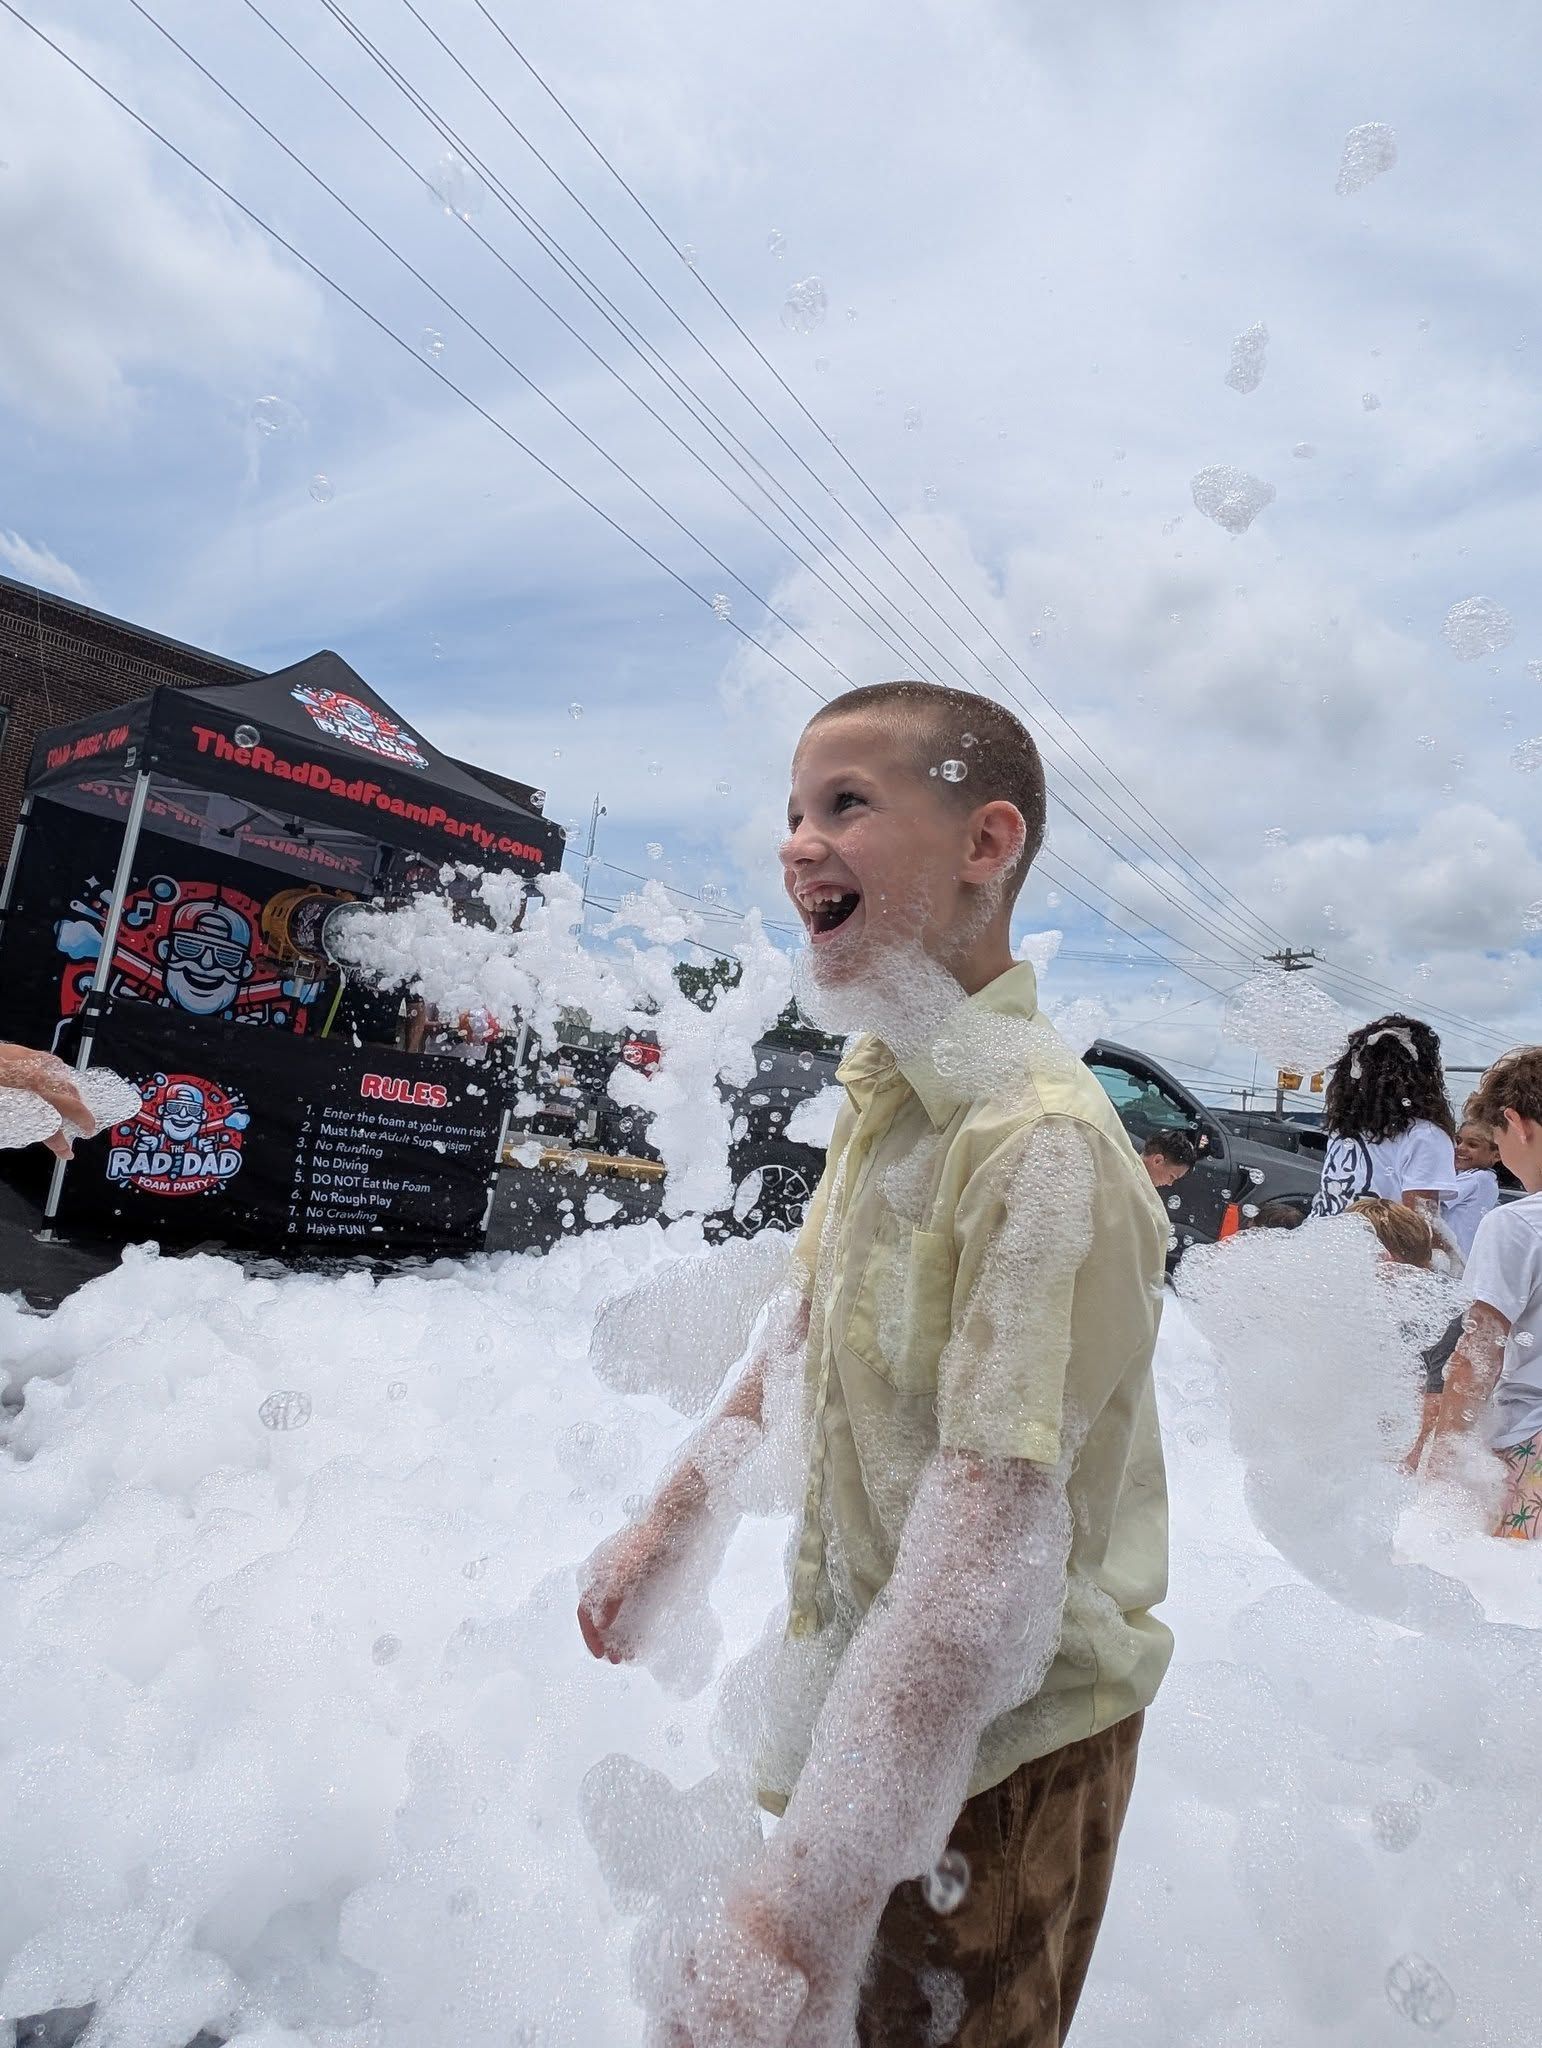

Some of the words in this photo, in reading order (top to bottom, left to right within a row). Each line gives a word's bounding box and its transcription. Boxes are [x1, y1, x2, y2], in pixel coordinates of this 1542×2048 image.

[317, 717, 371, 743] RAD
[378, 738, 425, 766] DAD
[191, 725, 543, 863] TheRadDadFoamParty.com
[361, 1073, 447, 1107] RULES
[323, 1107, 355, 1120] Enter
[357, 1112, 375, 1123] the
[377, 1114, 405, 1128] foam
[408, 1120, 418, 1129] at
[420, 1123, 442, 1133] your
[445, 1126, 466, 1136] own
[469, 1126, 486, 1138] risk
[320, 1124, 348, 1137] Must
[351, 1128, 377, 1140] have
[379, 1131, 409, 1144] Adult
[412, 1136, 471, 1151] Supvision
[170, 1145, 185, 1153] THE
[315, 1140, 332, 1151] No
[336, 1142, 383, 1159] Running
[109, 1150, 173, 1178] RAD
[181, 1150, 240, 1177] DAD
[312, 1156, 330, 1167] No
[332, 1159, 369, 1173] Diving
[138, 1177, 170, 1191] FOAM
[173, 1178, 209, 1192] PARTY
[312, 1173, 331, 1184] DO
[334, 1175, 361, 1187] NOT
[363, 1178, 380, 1189] Eat
[382, 1180, 399, 1190] the
[401, 1181, 431, 1193] Foam
[310, 1190, 328, 1202] No
[331, 1192, 367, 1207] Rough
[369, 1194, 392, 1208] Play
[306, 1207, 323, 1218] No
[326, 1208, 377, 1222] Crawling
[306, 1223, 336, 1236] Have
[338, 1224, 366, 1235] FUN!
